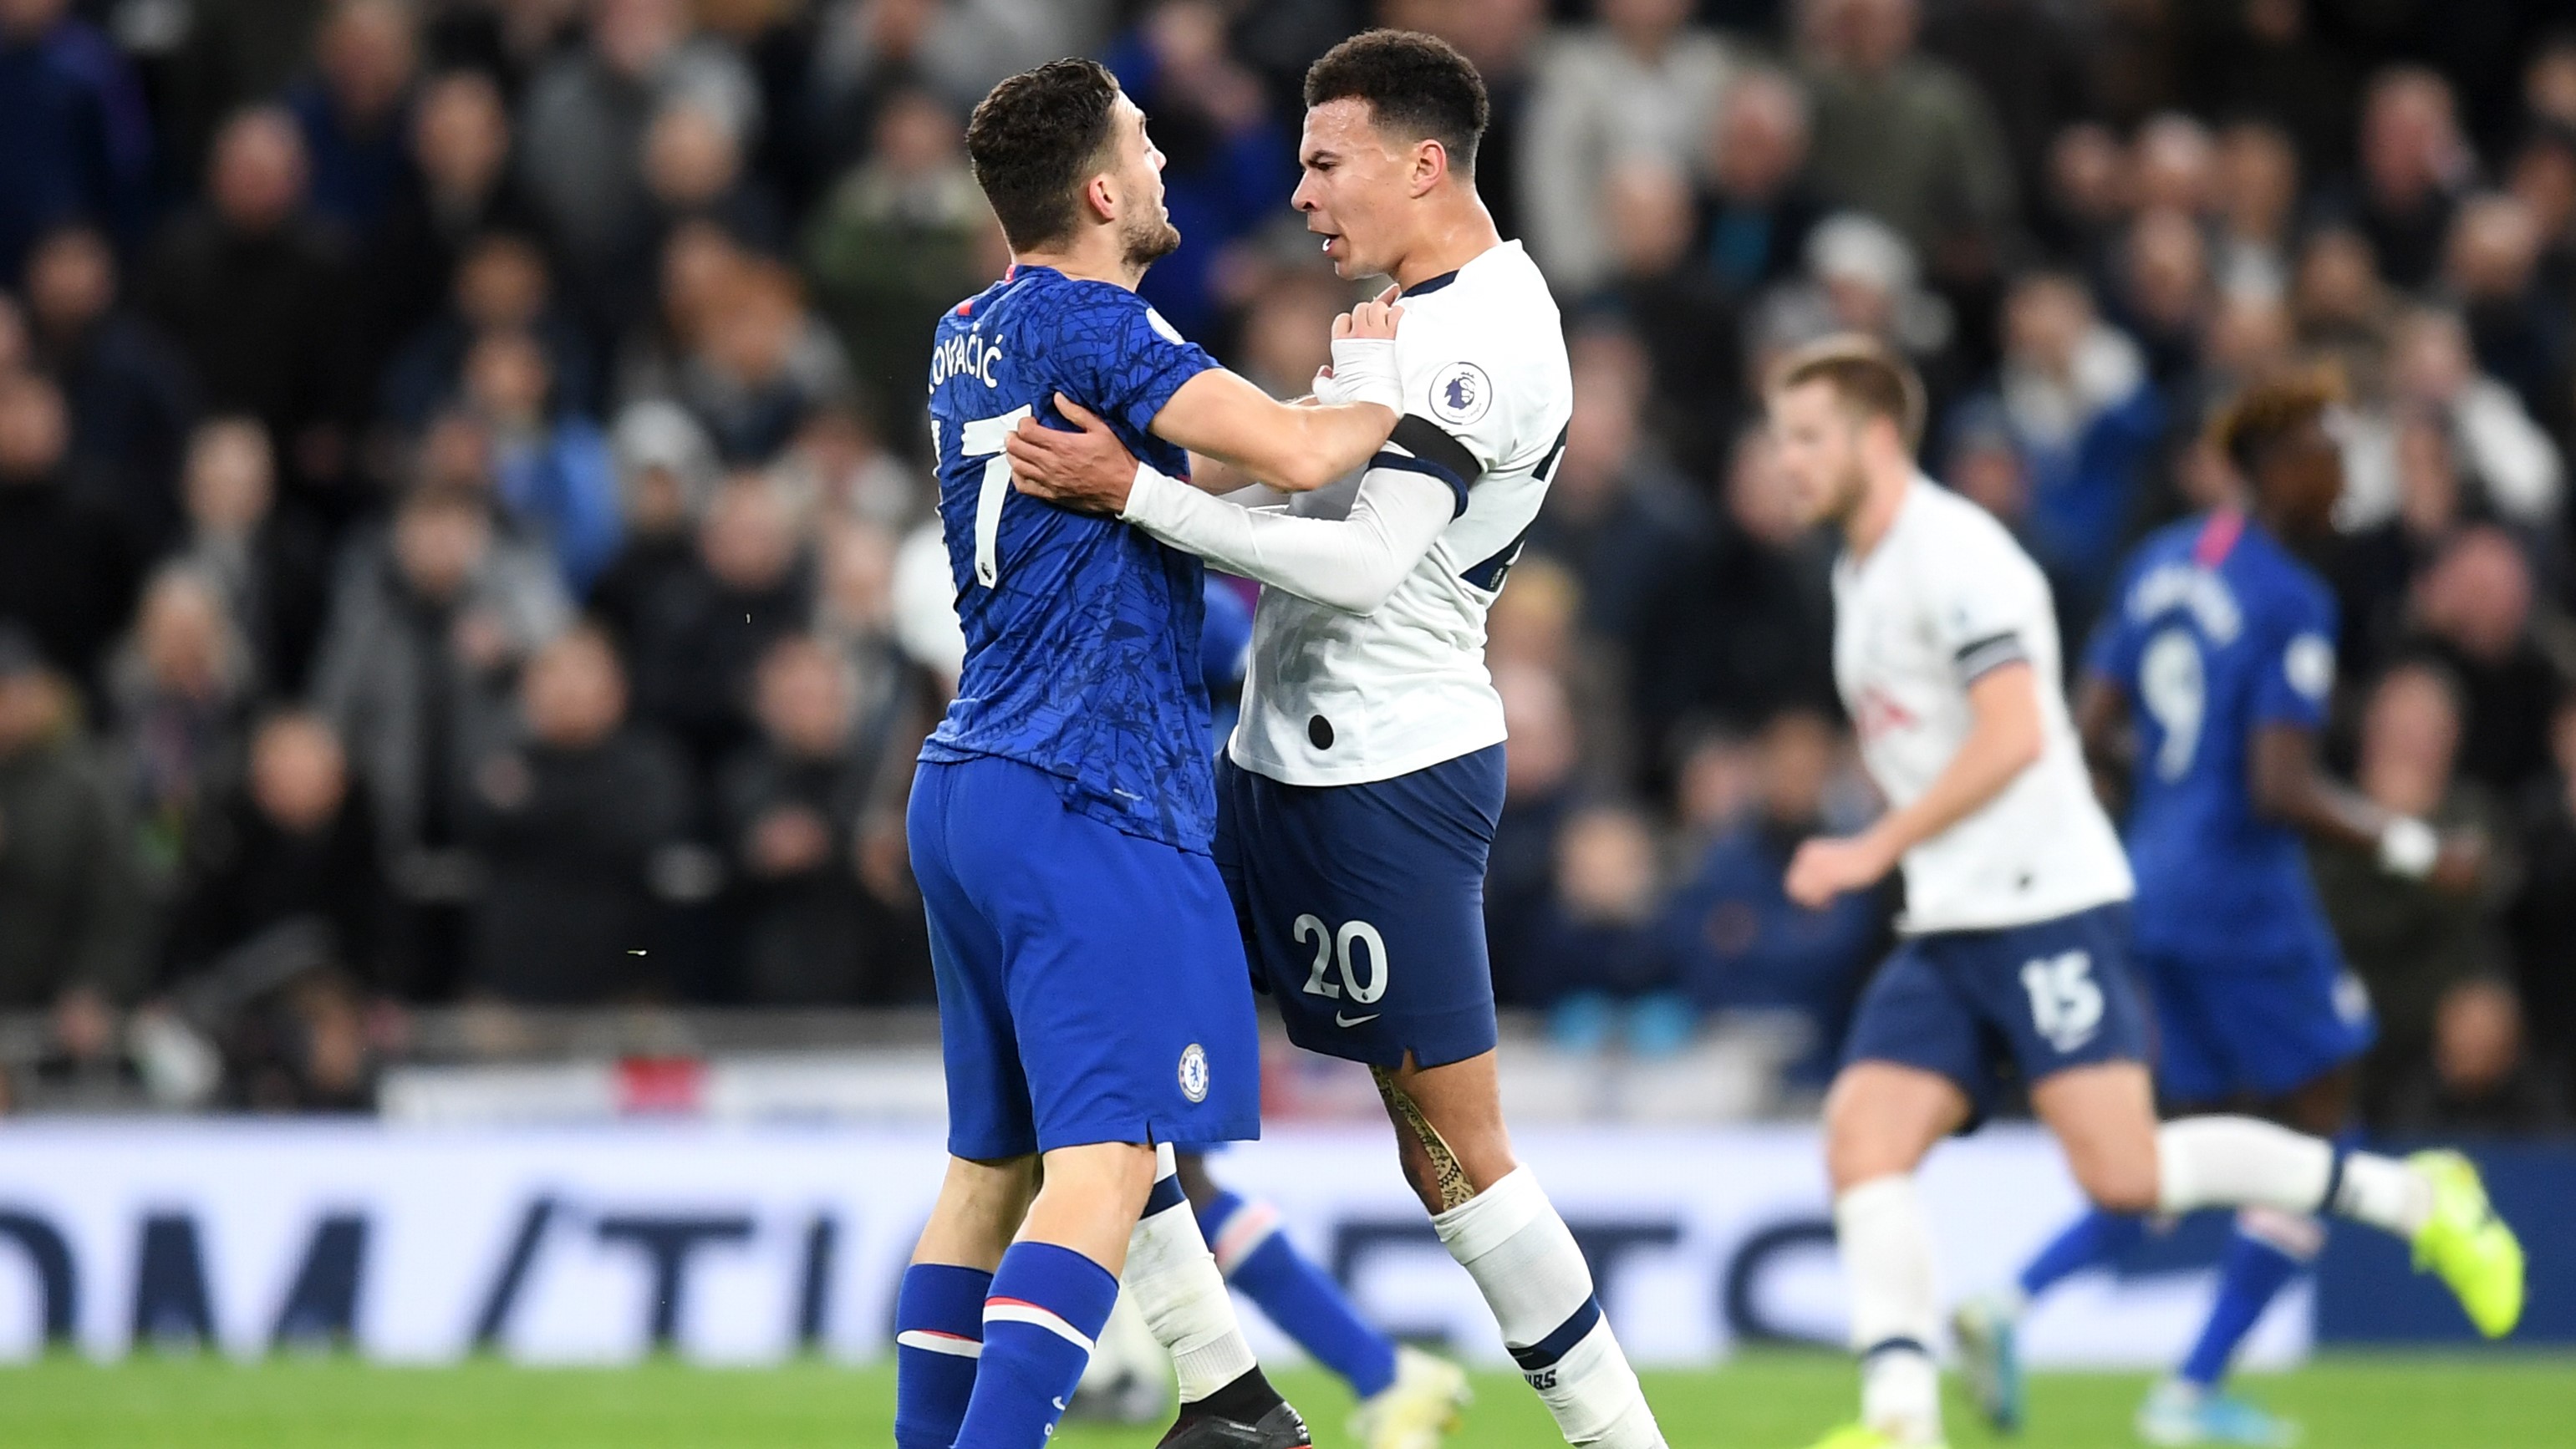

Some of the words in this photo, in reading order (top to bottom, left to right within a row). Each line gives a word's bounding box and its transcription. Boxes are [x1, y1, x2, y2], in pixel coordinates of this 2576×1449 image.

[929, 322, 1003, 394] OVAČIĆ
[2140, 627, 2204, 783] 9
[1293, 913, 1388, 1004] 20
[2019, 951, 2105, 1038] 15
